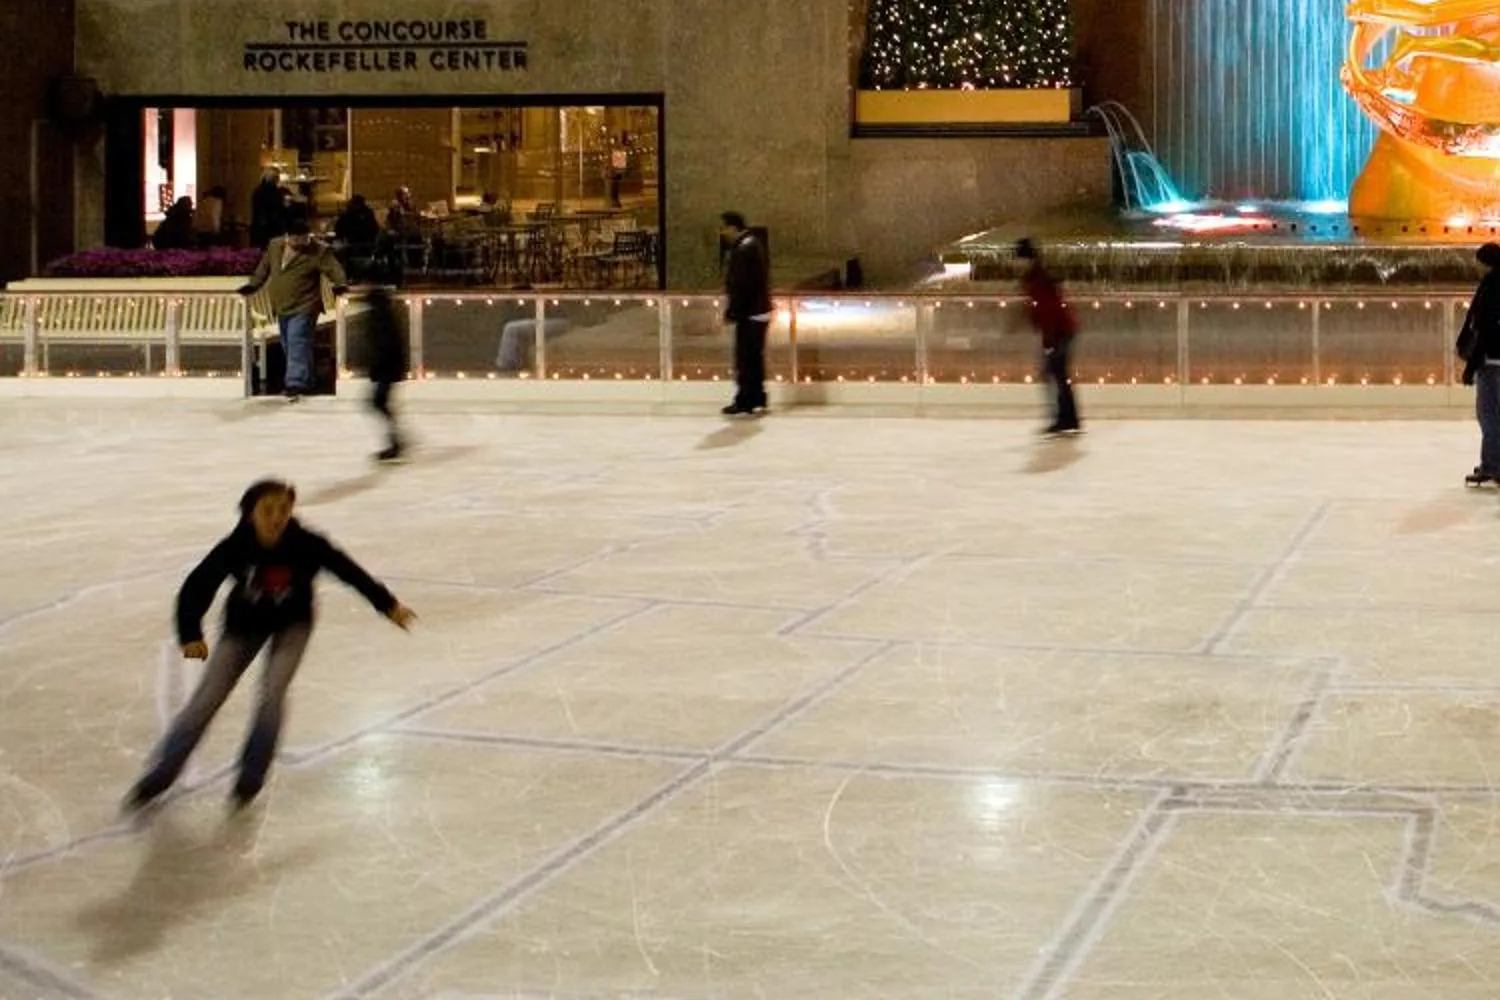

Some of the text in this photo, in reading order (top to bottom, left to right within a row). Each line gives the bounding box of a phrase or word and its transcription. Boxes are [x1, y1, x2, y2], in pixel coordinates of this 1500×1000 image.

[284, 19, 487, 41] THE CONCOURSE
[243, 50, 528, 72] ROCKEFELLER CENTER
